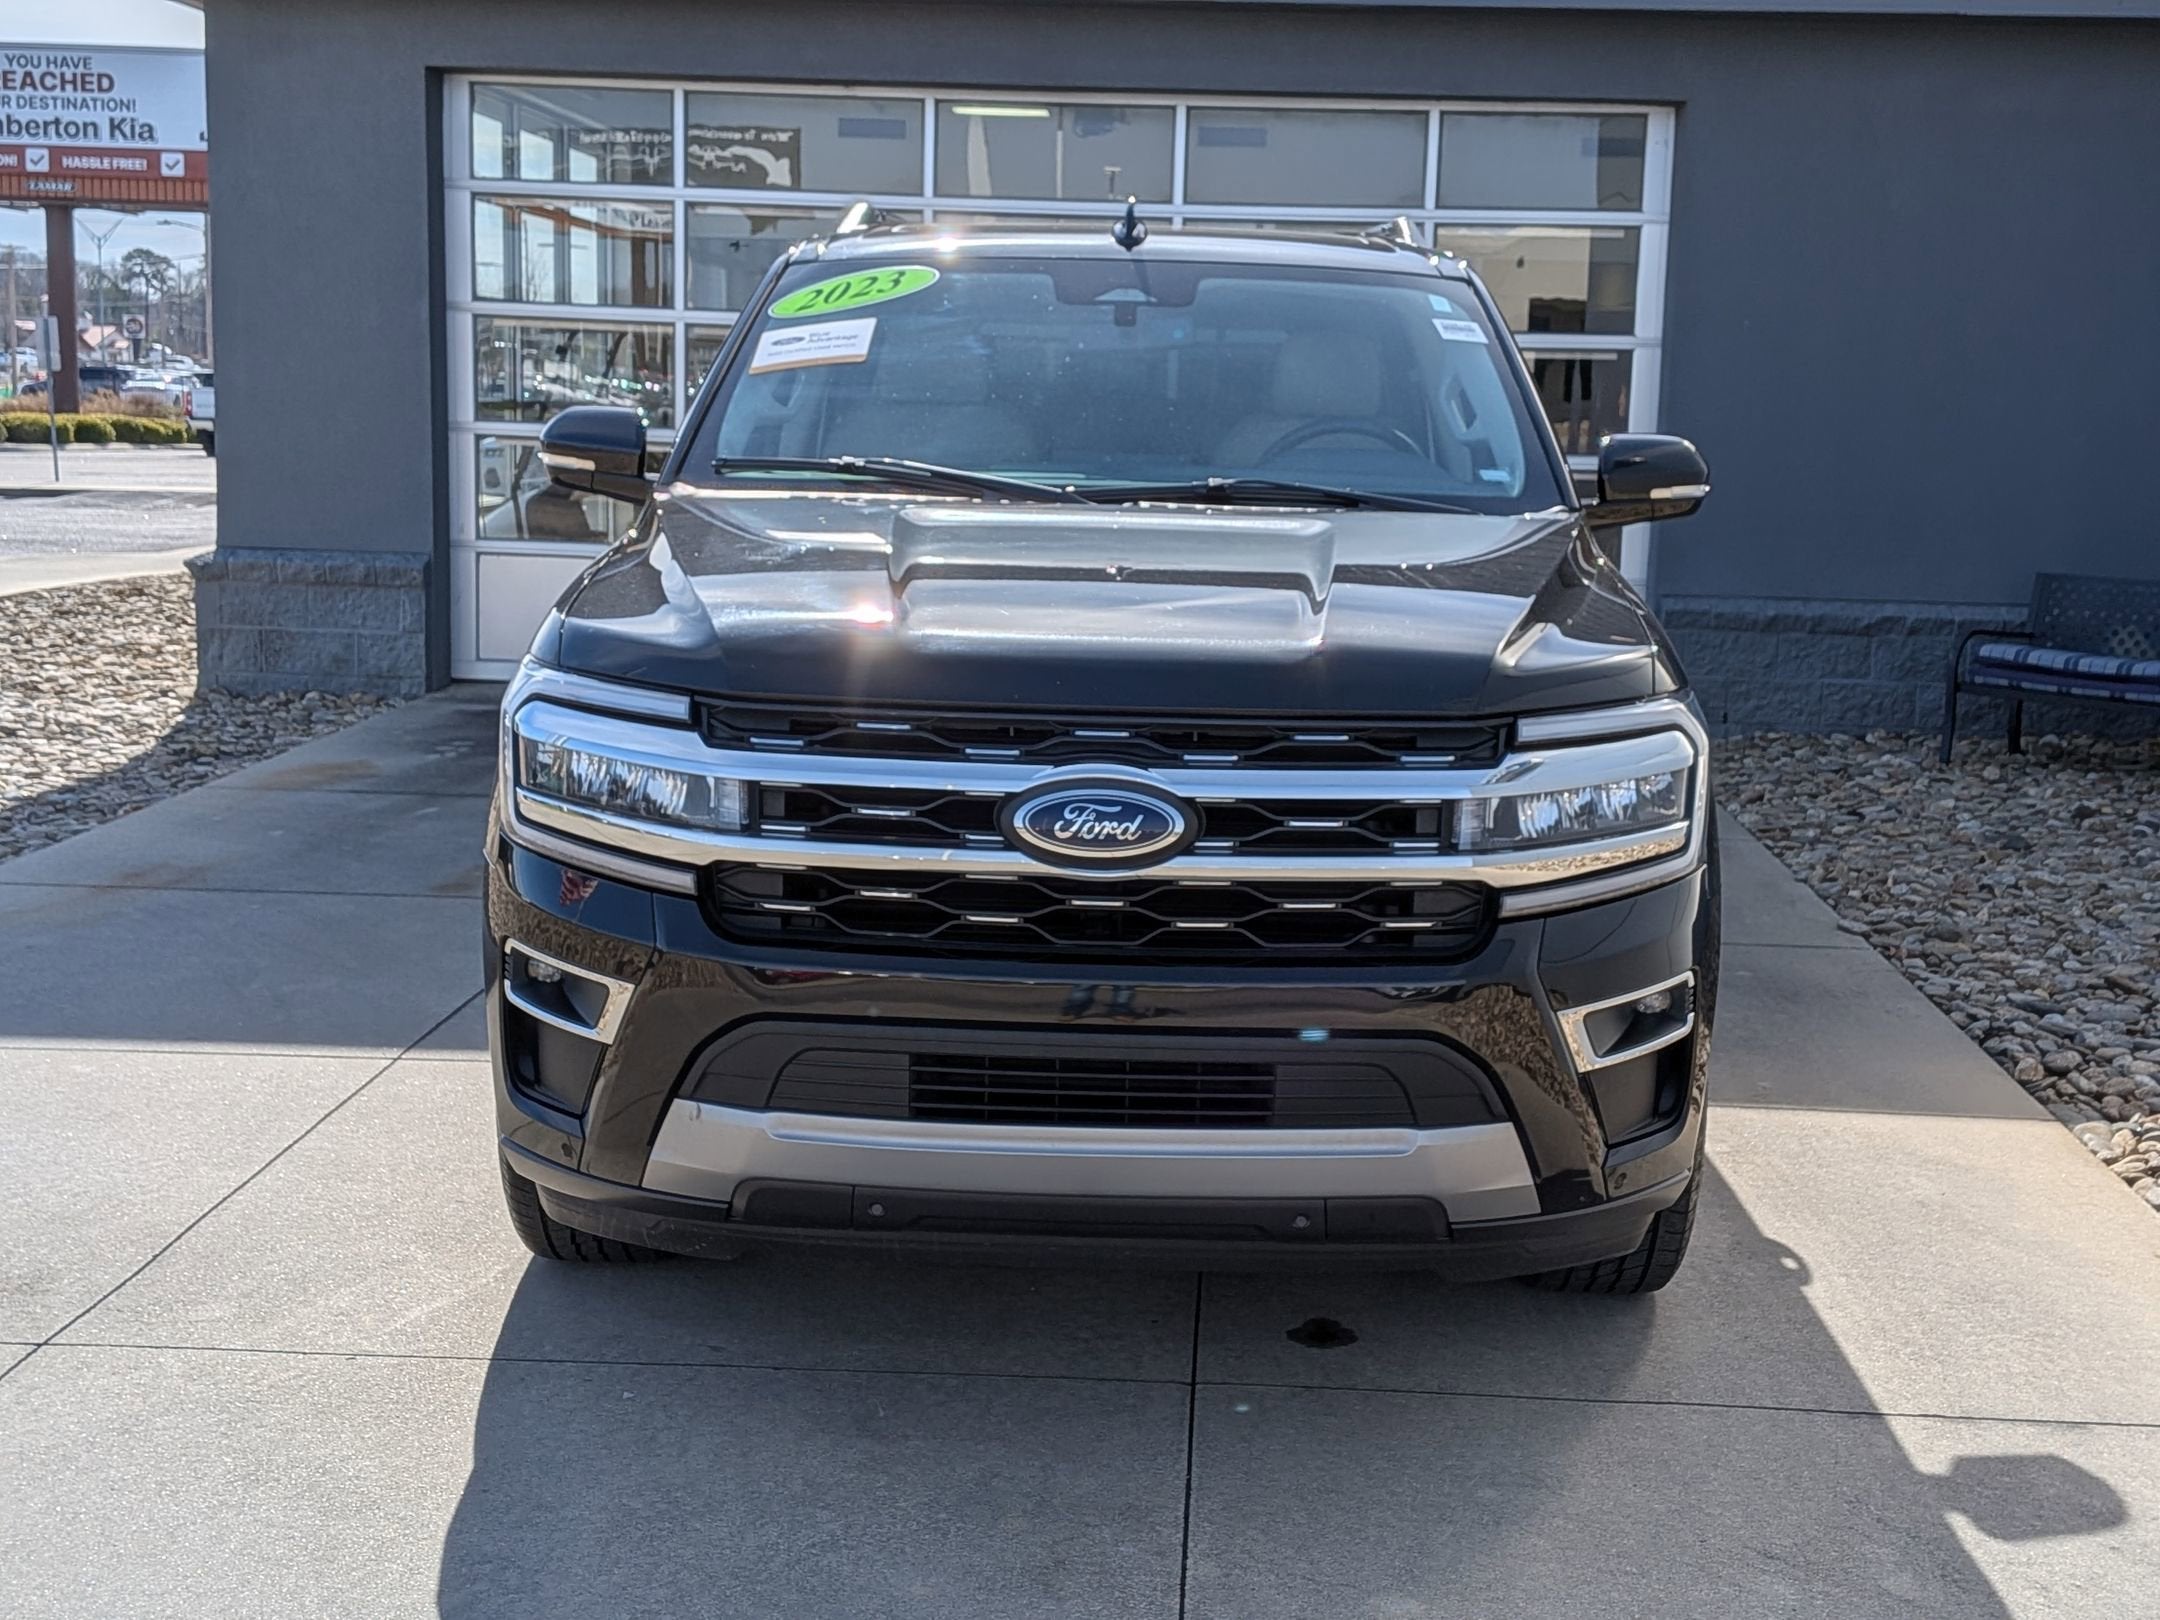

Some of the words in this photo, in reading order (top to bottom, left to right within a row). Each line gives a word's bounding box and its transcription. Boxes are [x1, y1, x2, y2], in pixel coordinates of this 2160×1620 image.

[4, 53, 42, 69] YOU
[46, 55, 93, 71] HAVE
[0, 70, 115, 93] EACHED
[16, 95, 137, 113] DESTINATION!
[108, 117, 155, 142] Kia
[62, 156, 111, 170] HASSLE
[112, 158, 147, 171] FREE!
[794, 270, 907, 313] 2023
[1053, 802, 1145, 841] Ford
